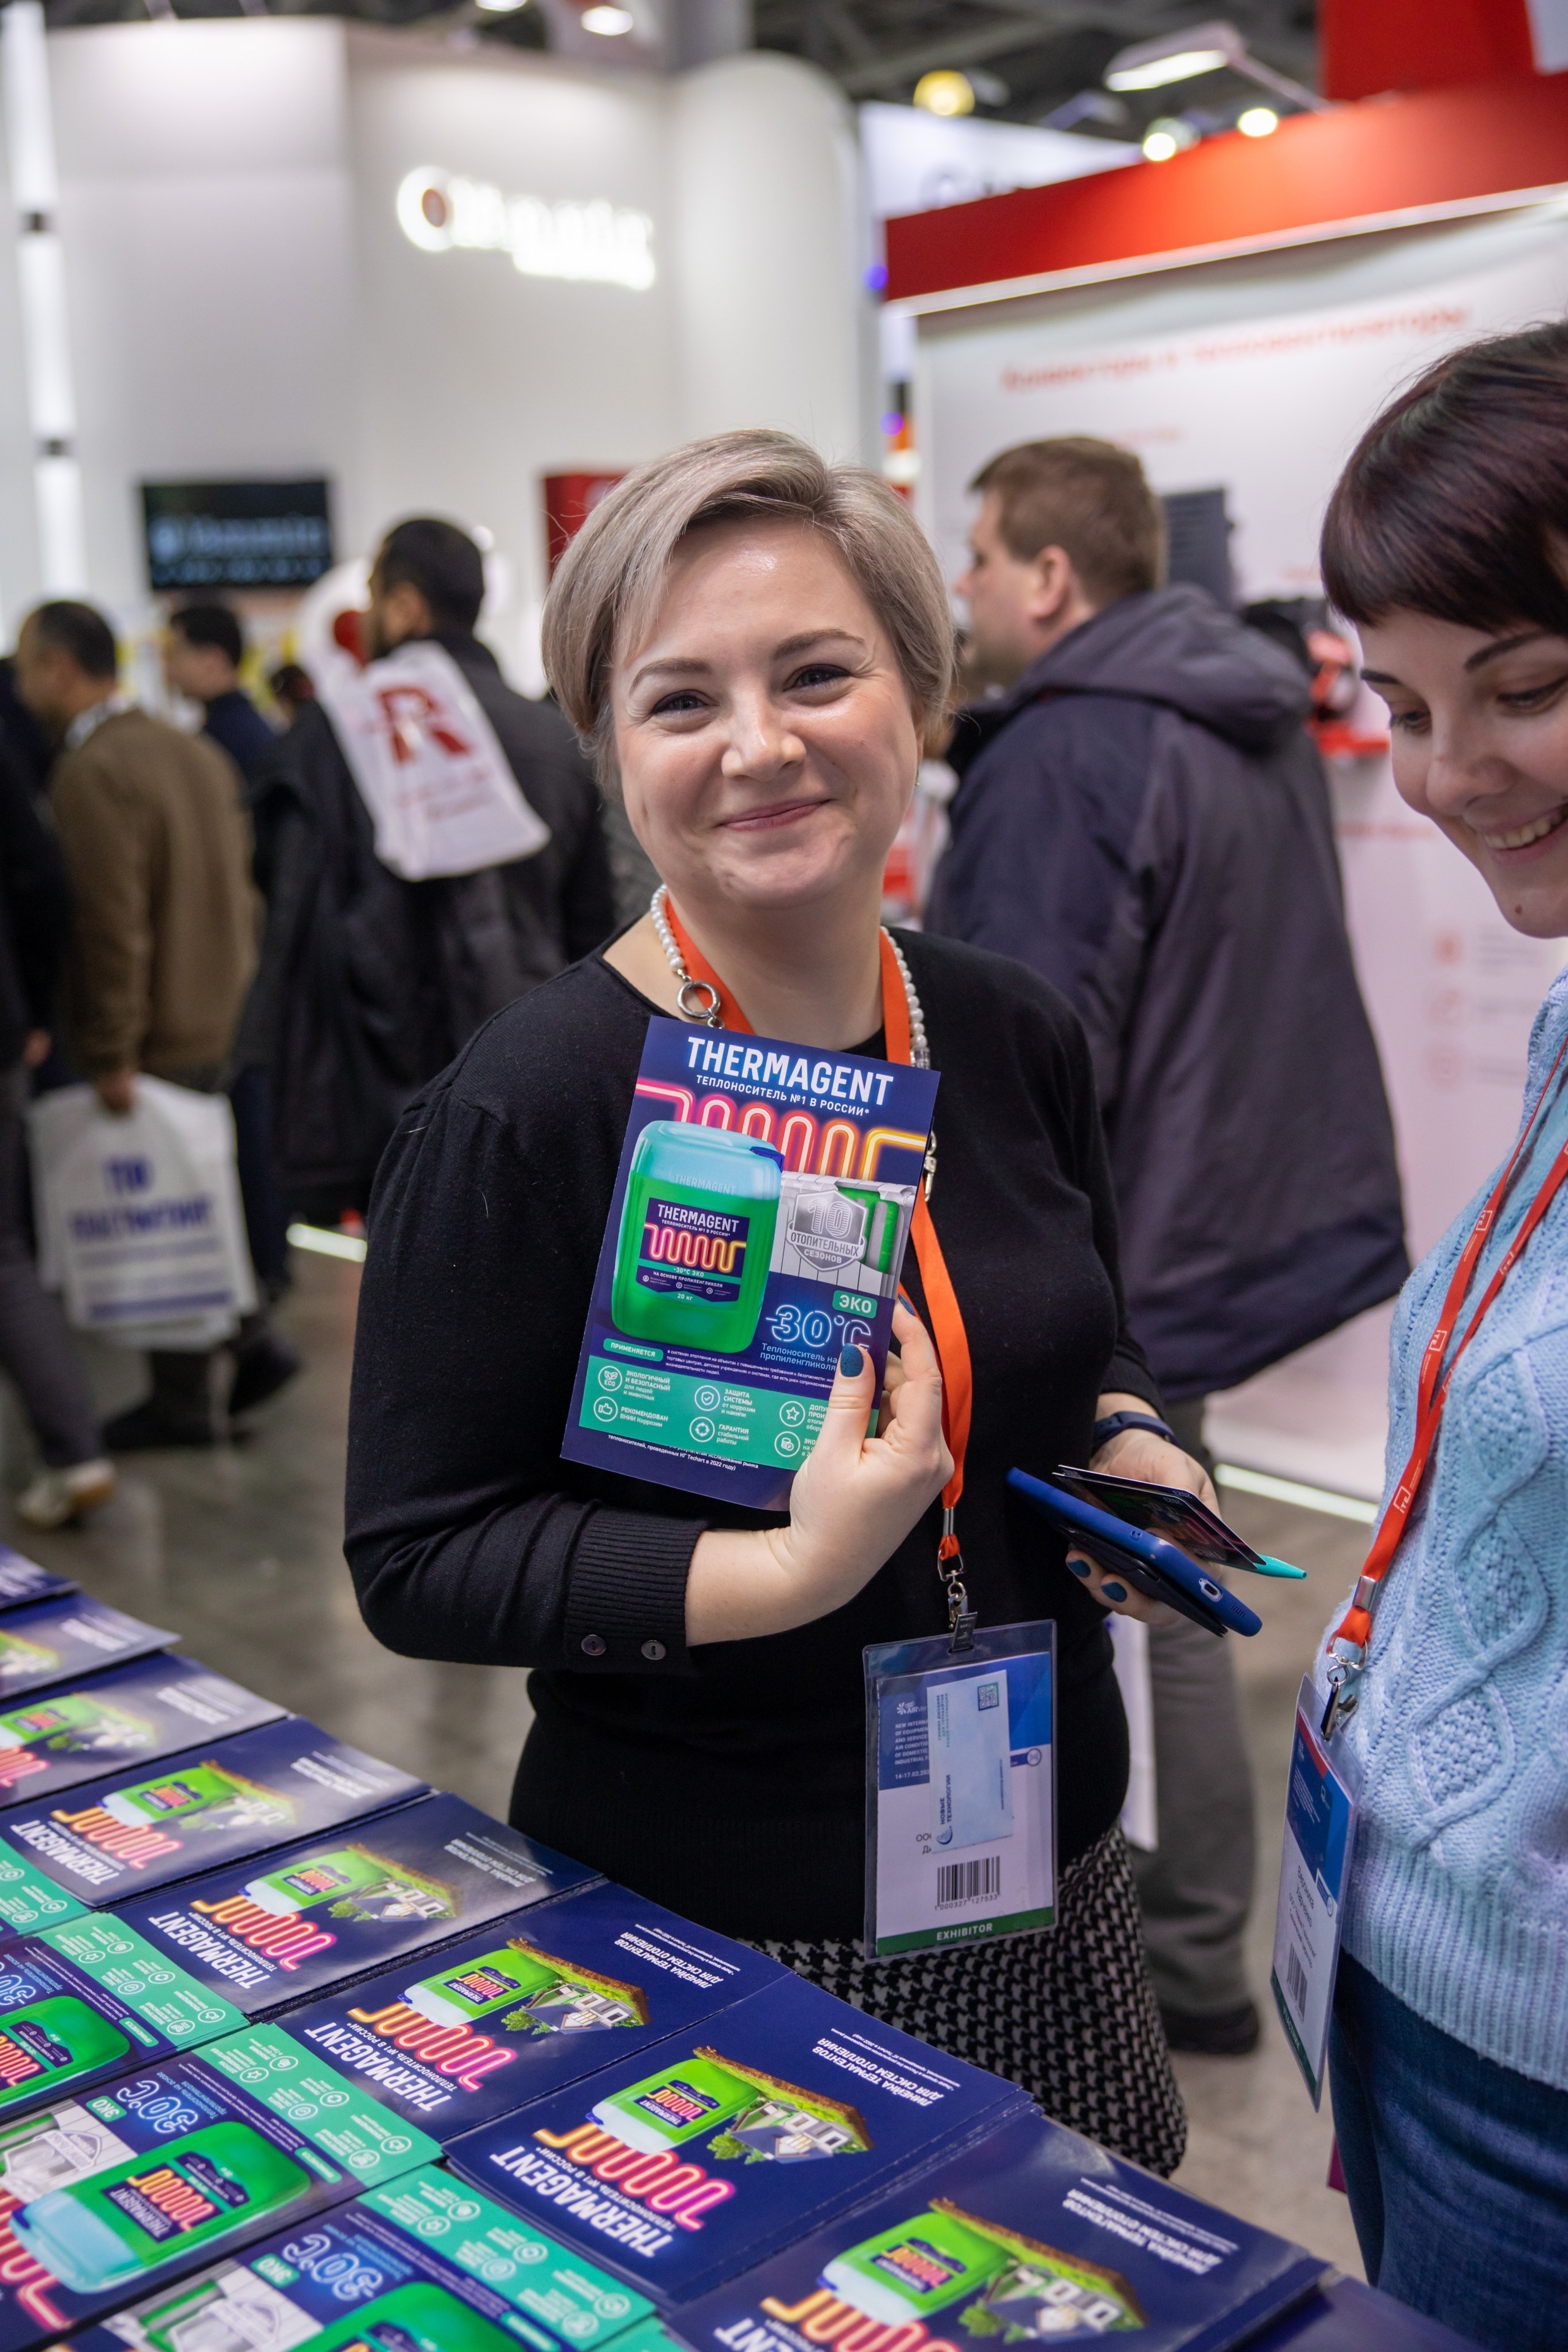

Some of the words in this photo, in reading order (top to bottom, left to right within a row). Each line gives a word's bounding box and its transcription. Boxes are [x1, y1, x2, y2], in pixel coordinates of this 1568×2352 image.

[688, 1037, 892, 1104] THERMAGENT
[696, 1075, 786, 1100] ТЕПЛОНОСИТЕЛЬ
[790, 1093, 805, 1104] №1
[810, 1098, 816, 1106] В
[658, 1204, 738, 1232] THERMAGENT
[662, 1219, 697, 1231] ТЕПЛОНОСИТЕЛЬ
[804, 1194, 856, 1239] 10
[790, 1231, 860, 1257] ОТОПИТЕЛЬНЫХ
[802, 1249, 842, 1263] СЕЗОНОВ
[678, 1276, 722, 1287] ПРОПИЛЕНГЛИКОЛЯ
[839, 1294, 871, 1313] ЭКО
[611, 1342, 655, 1356] ПРИМЕНЯЕТСЯ
[762, 1343, 824, 1361] Теплоноситель
[760, 1352, 835, 1371] пропиленгликоля
[626, 1370, 669, 1384] ЭКОЛОГИЧНЫЙ
[631, 1378, 669, 1390] БЕЗОПАСНЫЙ
[628, 1391, 654, 1400] животных
[723, 1395, 752, 1405] СИСТЕМЫ
[725, 1389, 749, 1398] ЗАЩИТА
[620, 1406, 668, 1420] РЕКОМЕНДОВАН
[636, 1417, 662, 1427] Коррозии
[717, 1431, 748, 1440] стабильной
[718, 1424, 748, 1434] ГАРАНТИЯ
[894, 1756, 924, 1765] INDUSTRIAL
[12, 1821, 119, 1884] THERMAGENT
[937, 1923, 992, 1940] EXHIBITOR
[149, 1912, 273, 1988] THERMAGENT
[614, 1939, 671, 1969] ТЕРМАГЕНТОВ
[620, 1932, 669, 1958] ОТОПЛЕНИЯ
[666, 1956, 701, 1974] СИСТЕМ
[670, 1966, 712, 1988] ЛИНЕЙКА
[699, 1972, 723, 1983] ДЛЯ
[448, 1982, 482, 2002] THERMAGENT
[383, 2046, 398, 2054] №1
[817, 2038, 877, 2070] ОТОПЛЕНИЯ
[305, 2023, 450, 2111] THERMAGENT
[397, 2053, 456, 2091] ТЕПЛОНОСИТЕЛЬ
[812, 2046, 881, 2084] ТЕРМАГЕНТОВ
[875, 2068, 917, 2089] СИСТЕМ
[882, 2081, 932, 2106] ЛИНЕЙКА
[915, 2087, 943, 2100] ДЛЯ
[92, 2099, 119, 2117] ЭКО
[116, 2080, 198, 2133] -30°C
[491, 2147, 671, 2255] THERMAGENT
[258, 2258, 291, 2282] ЭКО
[282, 2234, 382, 2300] -30°C
